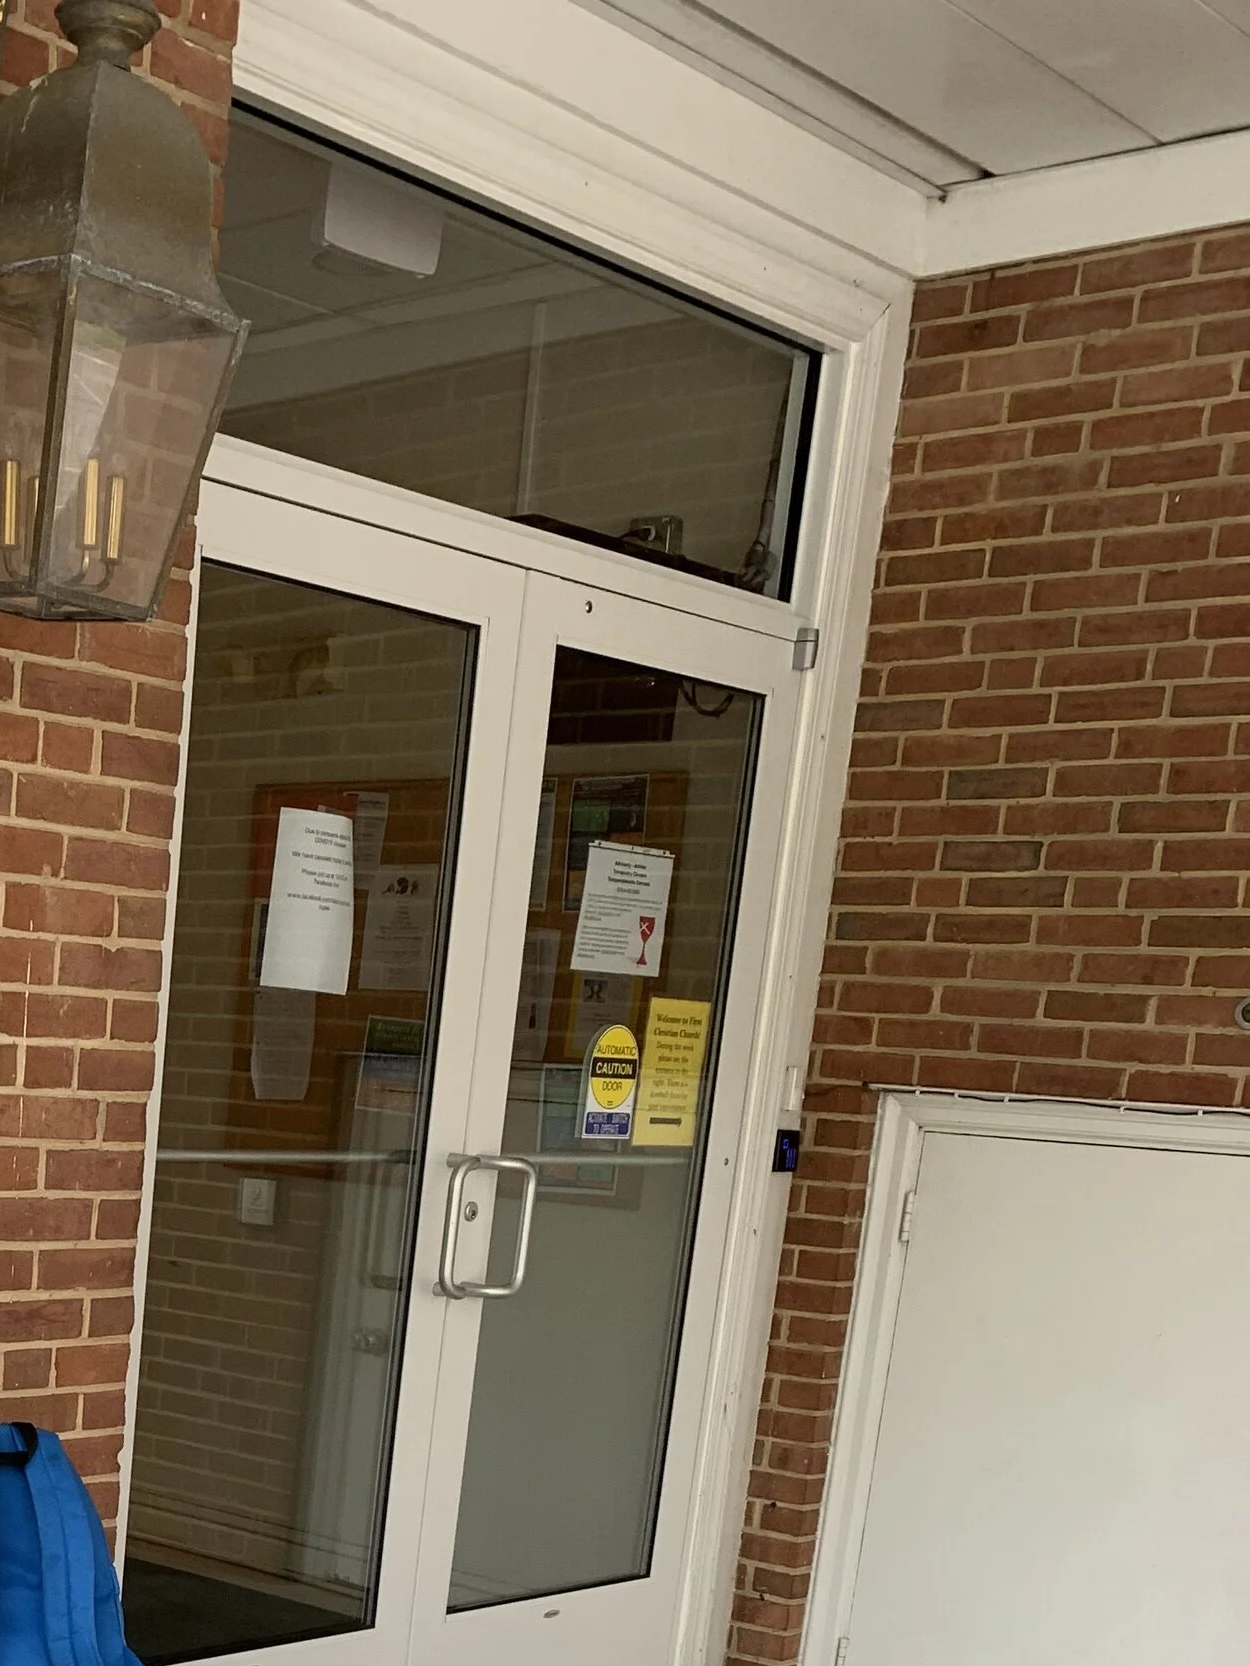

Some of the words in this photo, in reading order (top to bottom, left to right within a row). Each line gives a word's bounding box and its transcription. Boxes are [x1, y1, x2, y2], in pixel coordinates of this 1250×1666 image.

[654, 1027, 679, 1038] Christian
[597, 1045, 636, 1056] AUTOMATIC
[596, 1062, 633, 1075] CAUTION
[602, 1081, 623, 1091] DOOR
